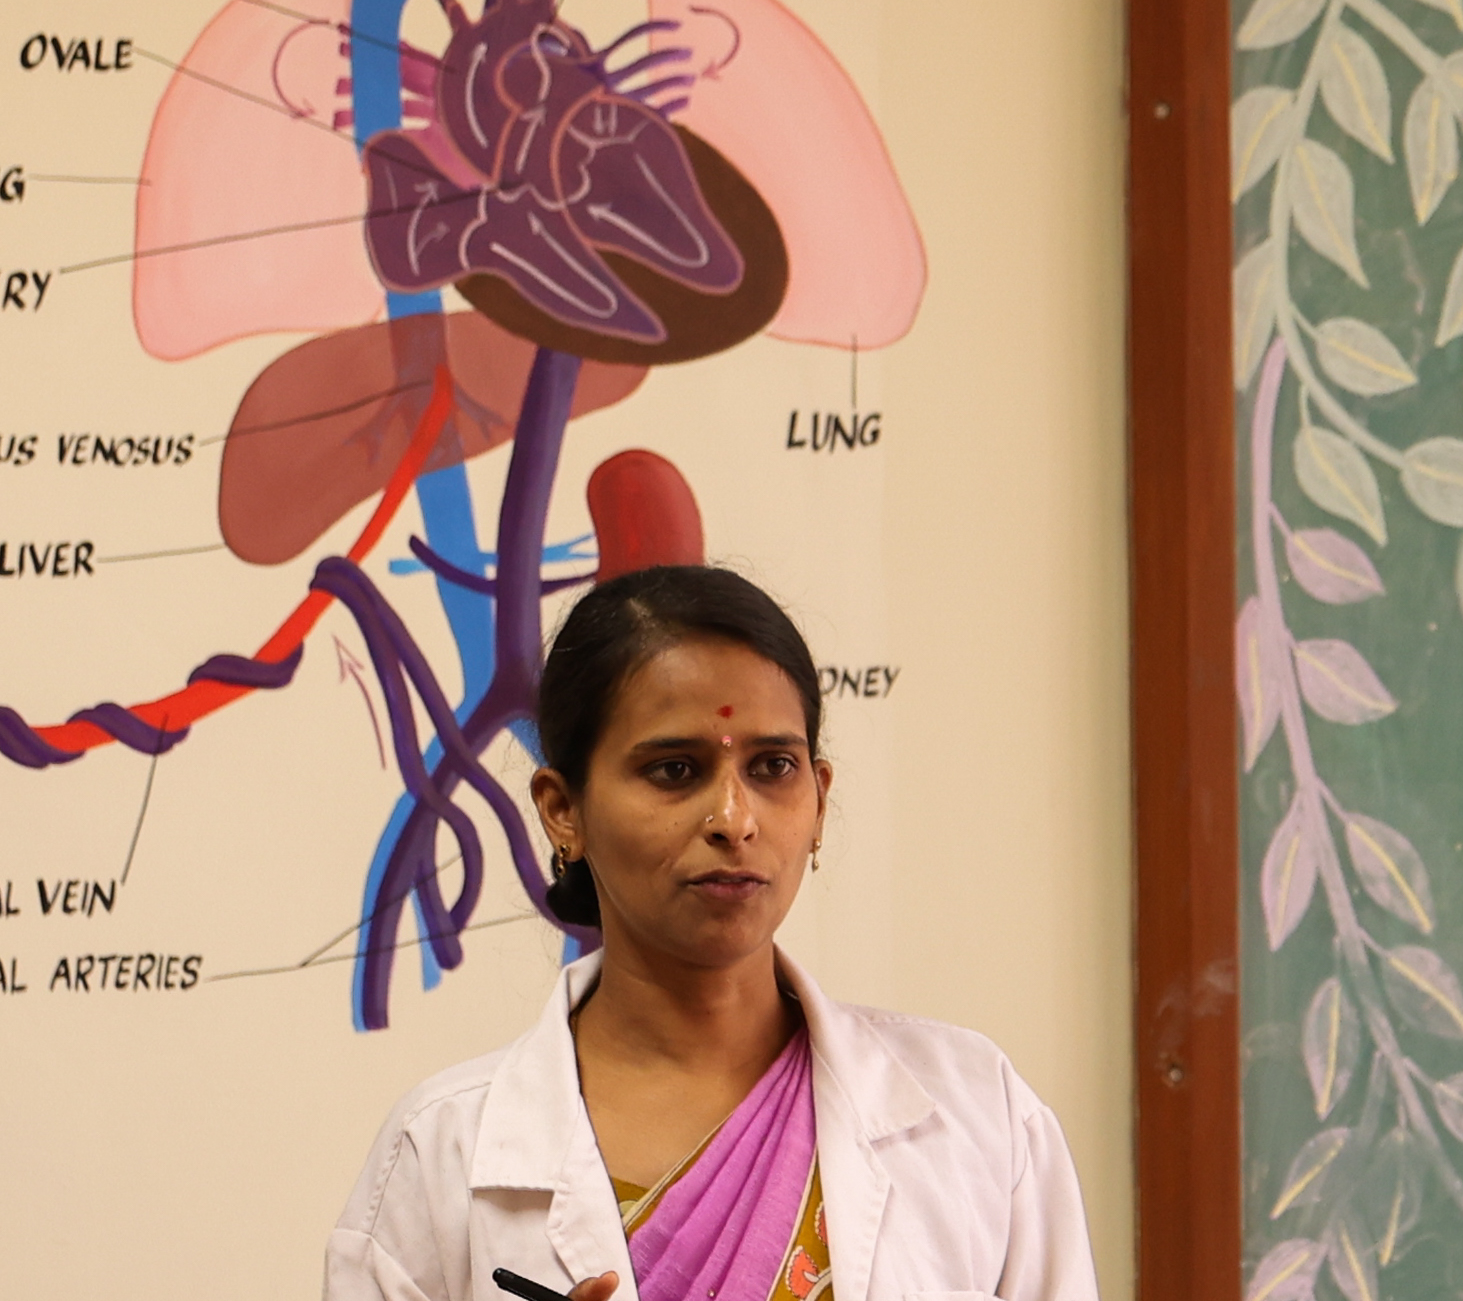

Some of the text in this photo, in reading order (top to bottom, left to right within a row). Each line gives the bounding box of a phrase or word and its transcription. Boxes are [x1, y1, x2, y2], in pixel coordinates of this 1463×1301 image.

[19, 33, 132, 72] OVALE
[58, 434, 195, 467] VENOSUS
[786, 410, 882, 452] LUNG
[36, 877, 114, 918] VEIN
[49, 952, 203, 992] ARTERIES
